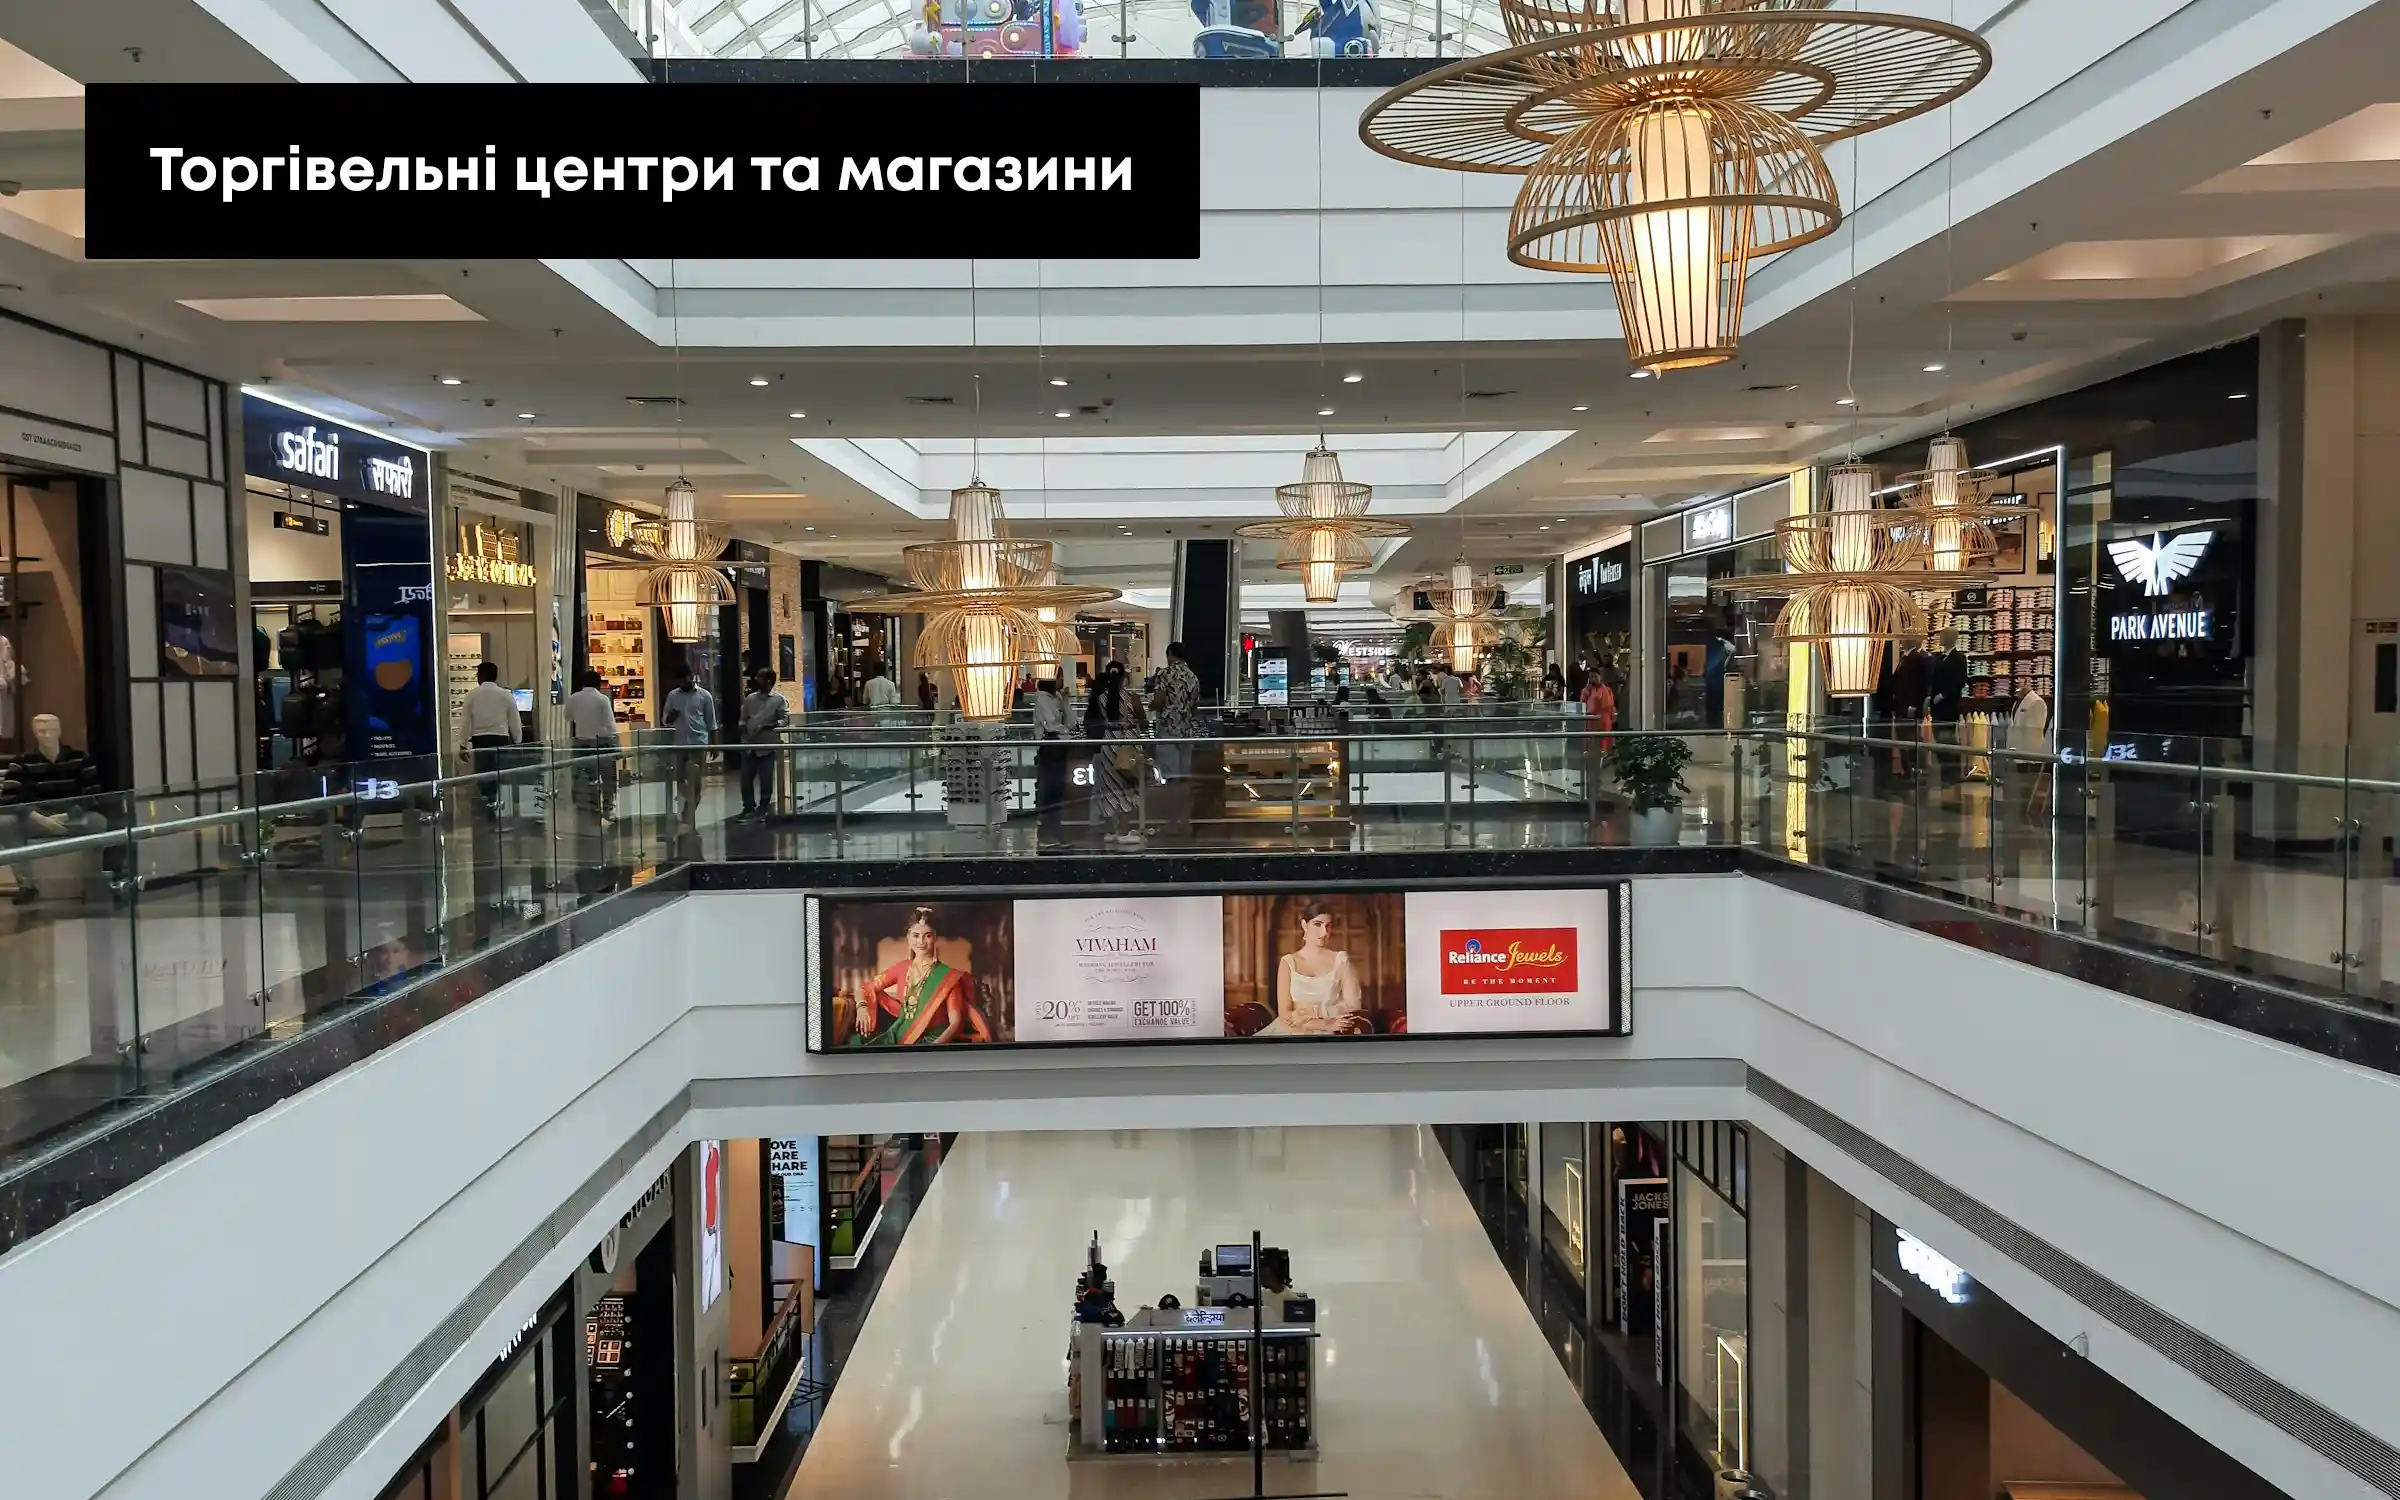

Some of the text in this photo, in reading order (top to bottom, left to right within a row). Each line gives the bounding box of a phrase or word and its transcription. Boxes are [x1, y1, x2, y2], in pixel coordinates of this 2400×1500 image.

[278, 426, 339, 480] safari
[2111, 611, 2206, 640] PARK AVENUE
[1333, 639, 1394, 657] WESTSIDE
[1076, 937, 1157, 952] VIVAHAM
[1448, 940, 1567, 970] Reliance Jewels
[1509, 977, 1557, 985] MOMENT
[1134, 1001, 1157, 1017] GET
[1158, 1000, 1190, 1016] 100%
[1449, 997, 1571, 1008] UPPER GROUND FLOOR
[1134, 1017, 1190, 1026] EXCHANGE VALUE
[771, 1140, 797, 1150] OVE
[771, 1151, 799, 1160] ARE
[771, 1161, 808, 1171] HARE
